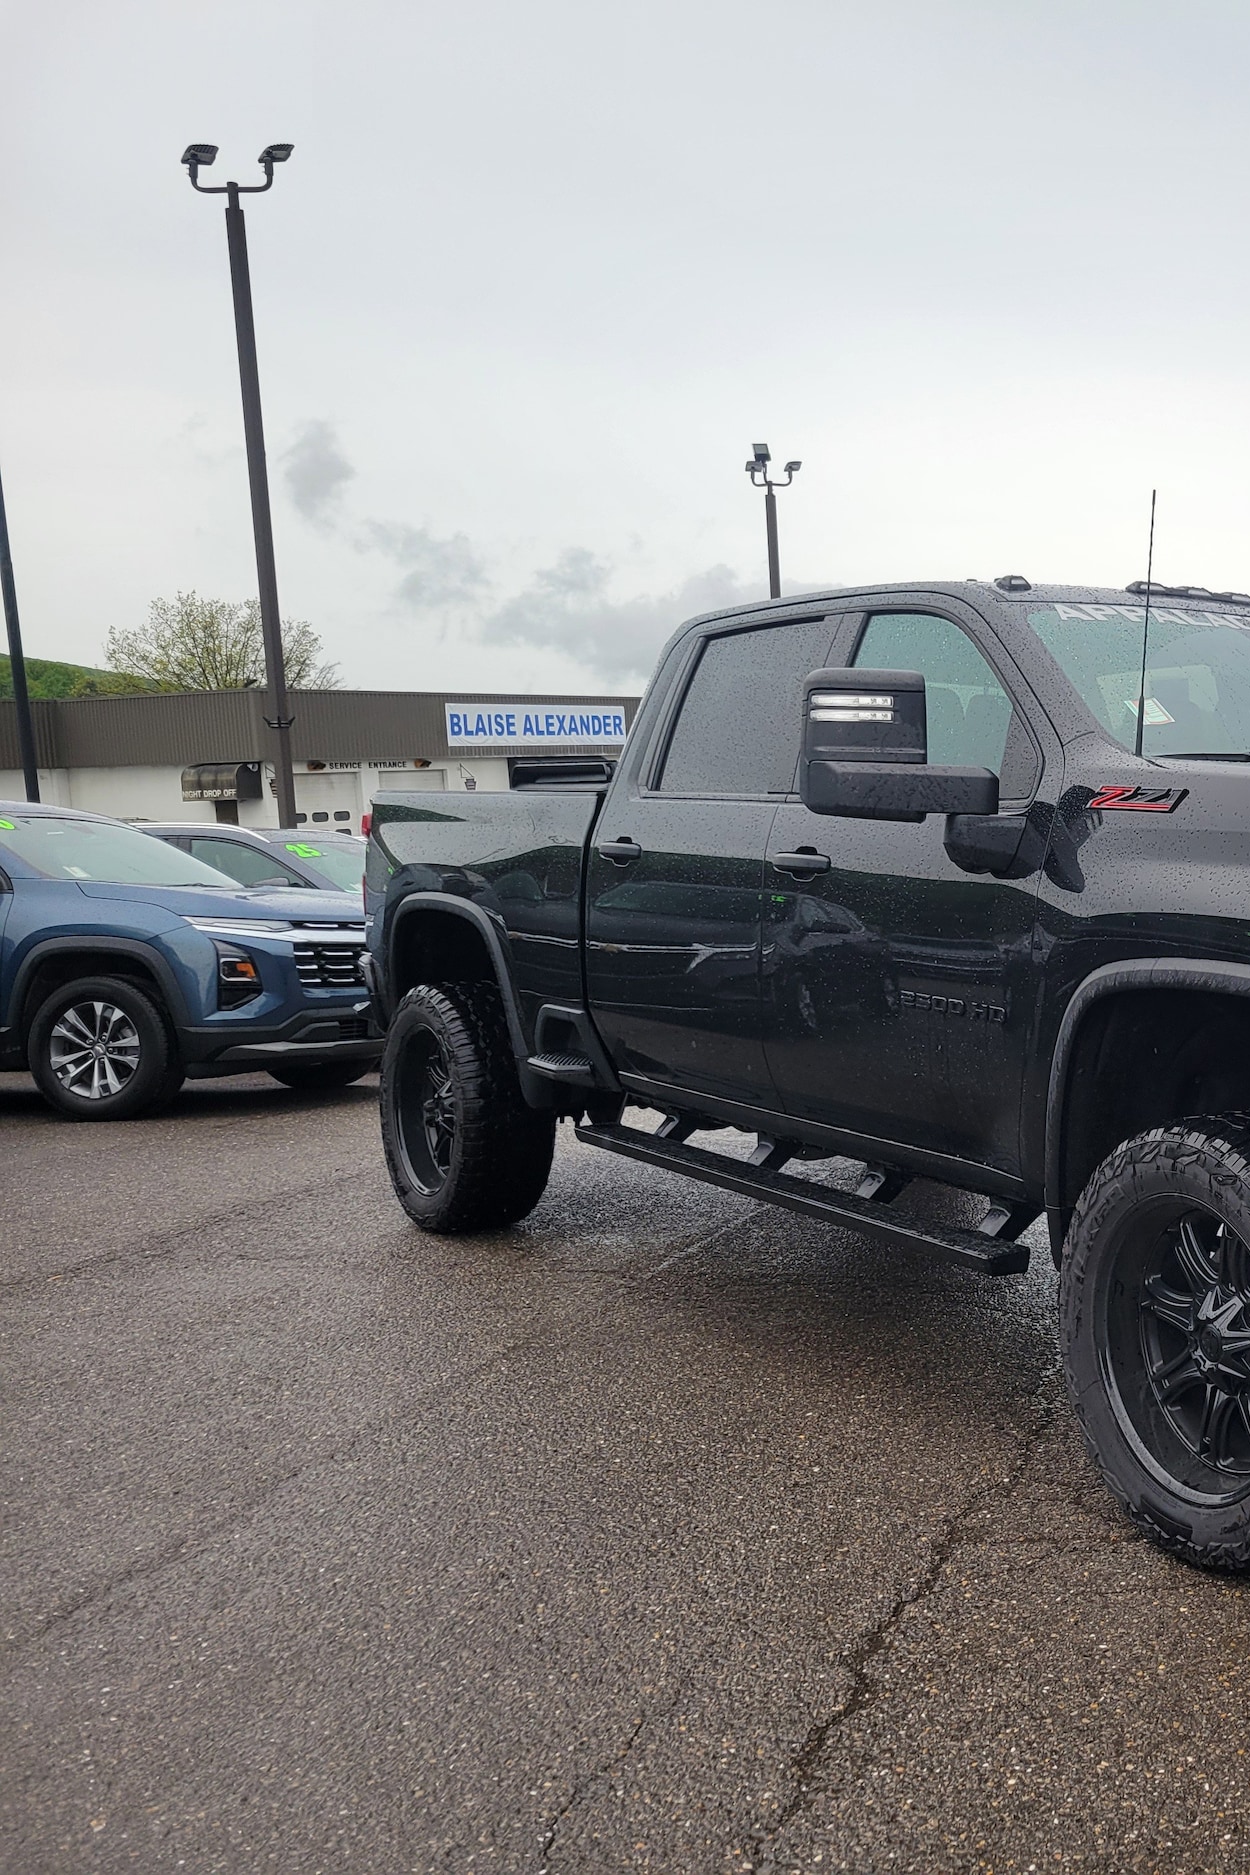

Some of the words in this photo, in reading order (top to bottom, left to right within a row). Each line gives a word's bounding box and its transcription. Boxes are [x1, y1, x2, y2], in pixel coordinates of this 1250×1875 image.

[449, 713, 517, 737] BLAISE
[523, 714, 625, 736] ALEXANDER
[329, 762, 362, 770] SERVICE
[368, 761, 408, 769] ENTRANCE
[183, 790, 202, 799] NIGHT
[203, 789, 222, 798] DROP
[223, 788, 238, 797] OFF
[1085, 786, 1189, 813] Z71
[285, 843, 322, 858] 25
[971, 1002, 1007, 1022] HD
